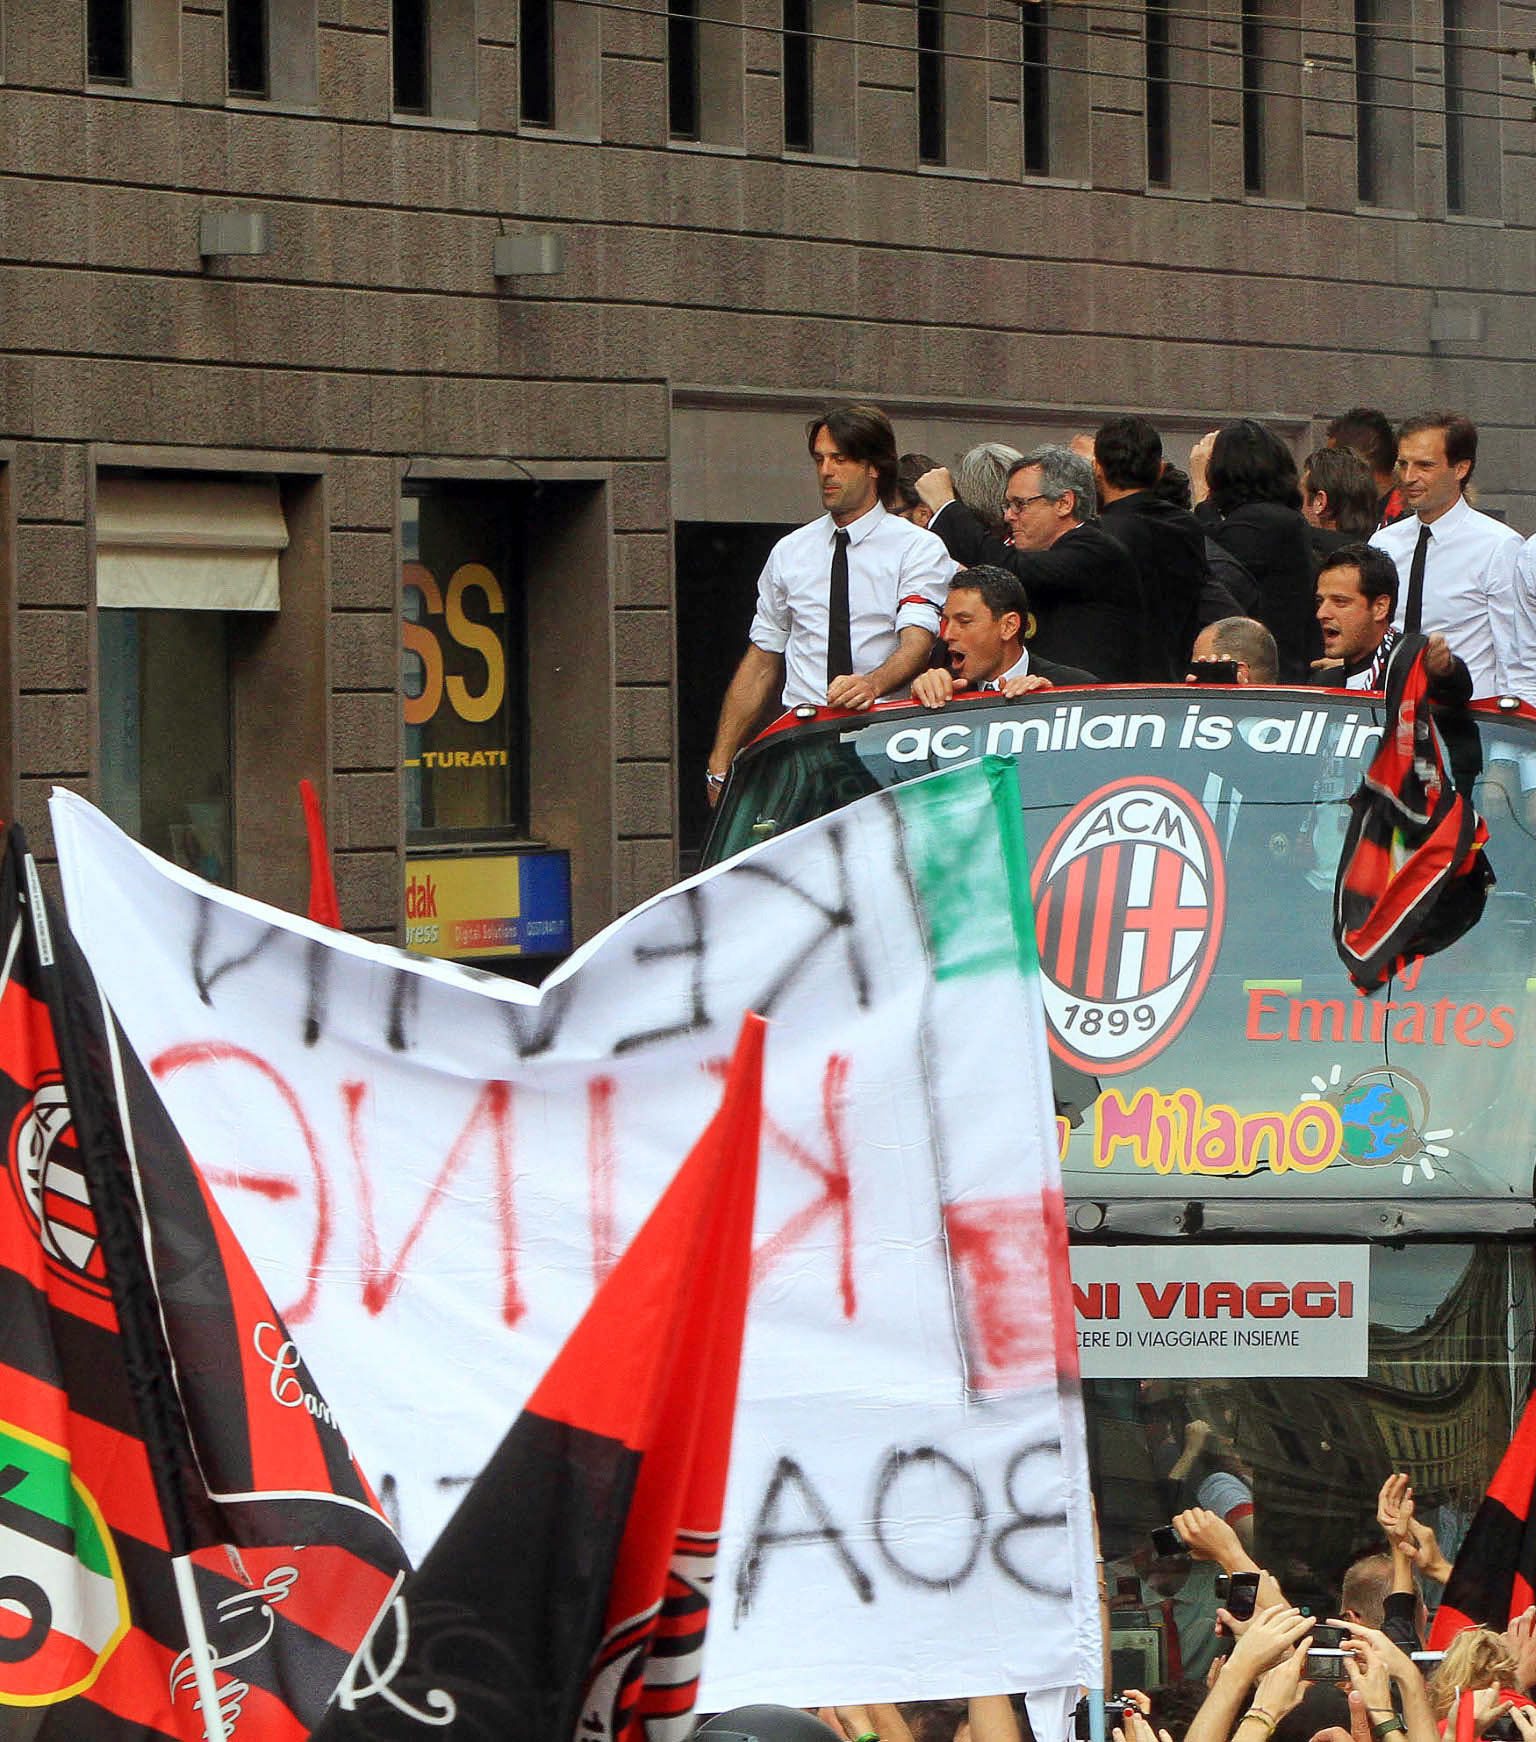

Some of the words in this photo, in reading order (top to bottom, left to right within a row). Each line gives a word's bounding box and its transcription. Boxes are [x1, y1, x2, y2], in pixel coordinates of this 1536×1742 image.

[886, 722, 972, 763] ac
[986, 705, 1168, 756] milan
[1179, 704, 1235, 750] is
[1248, 710, 1330, 755] all
[422, 751, 508, 768] TURATI
[1075, 798, 1187, 851] ACM
[1063, 1003, 1157, 1037] 1899
[1245, 987, 1516, 1049] Emirates
[1093, 1087, 1344, 1175] Milano
[1136, 1281, 1354, 1319] VIAGGI
[1116, 1331, 1132, 1347] DI
[1136, 1330, 1228, 1347] VIAGGIARE
[1234, 1330, 1300, 1347] INSIEME
